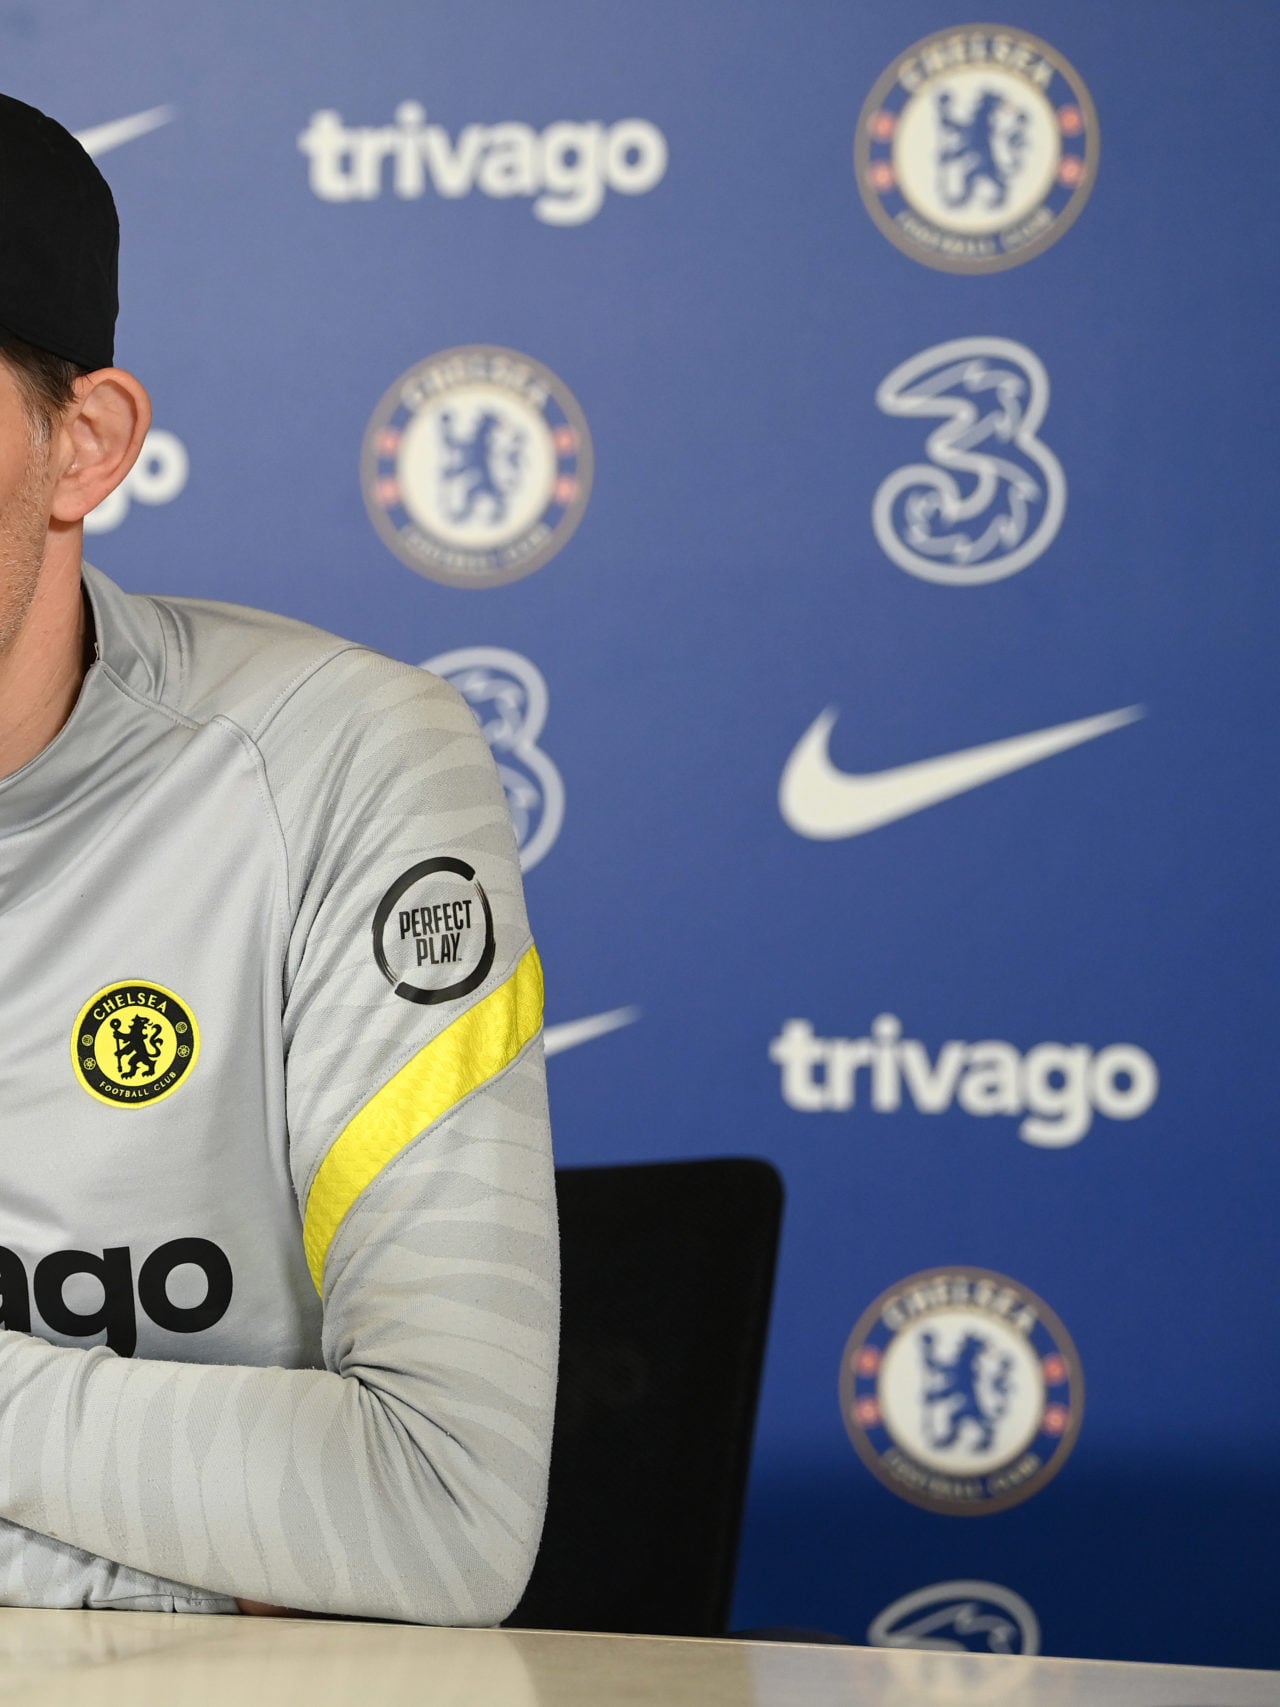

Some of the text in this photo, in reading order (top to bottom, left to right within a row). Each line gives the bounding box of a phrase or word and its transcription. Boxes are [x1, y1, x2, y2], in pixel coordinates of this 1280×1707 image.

[299, 102, 667, 226] trivago
[398, 900, 472, 940] PERFECT
[93, 992, 167, 1020] CHELSEA
[99, 1071, 177, 1098] FOOTBALL CLUB
[769, 1013, 1159, 1148] trivago
